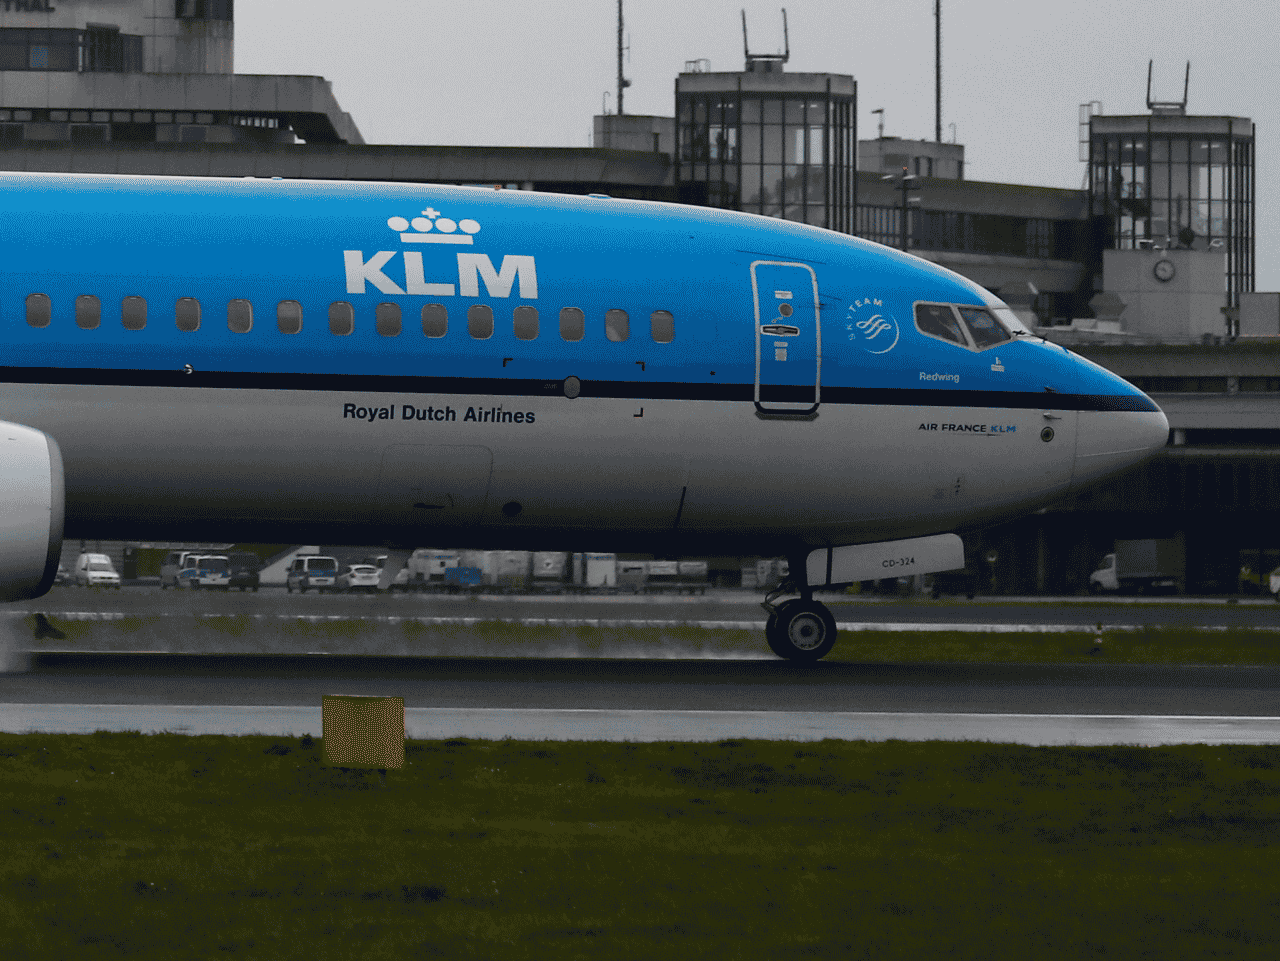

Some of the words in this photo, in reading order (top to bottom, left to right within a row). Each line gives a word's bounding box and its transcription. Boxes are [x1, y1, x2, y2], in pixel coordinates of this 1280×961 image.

[343, 250, 539, 299] KLM
[919, 371, 960, 384] Redwing
[343, 403, 395, 422] Royal
[402, 404, 456, 422] Dutch
[463, 406, 536, 424] Airlines
[918, 423, 938, 431] AIR
[942, 424, 987, 433] FRANCE
[990, 425, 1017, 433] KLM
